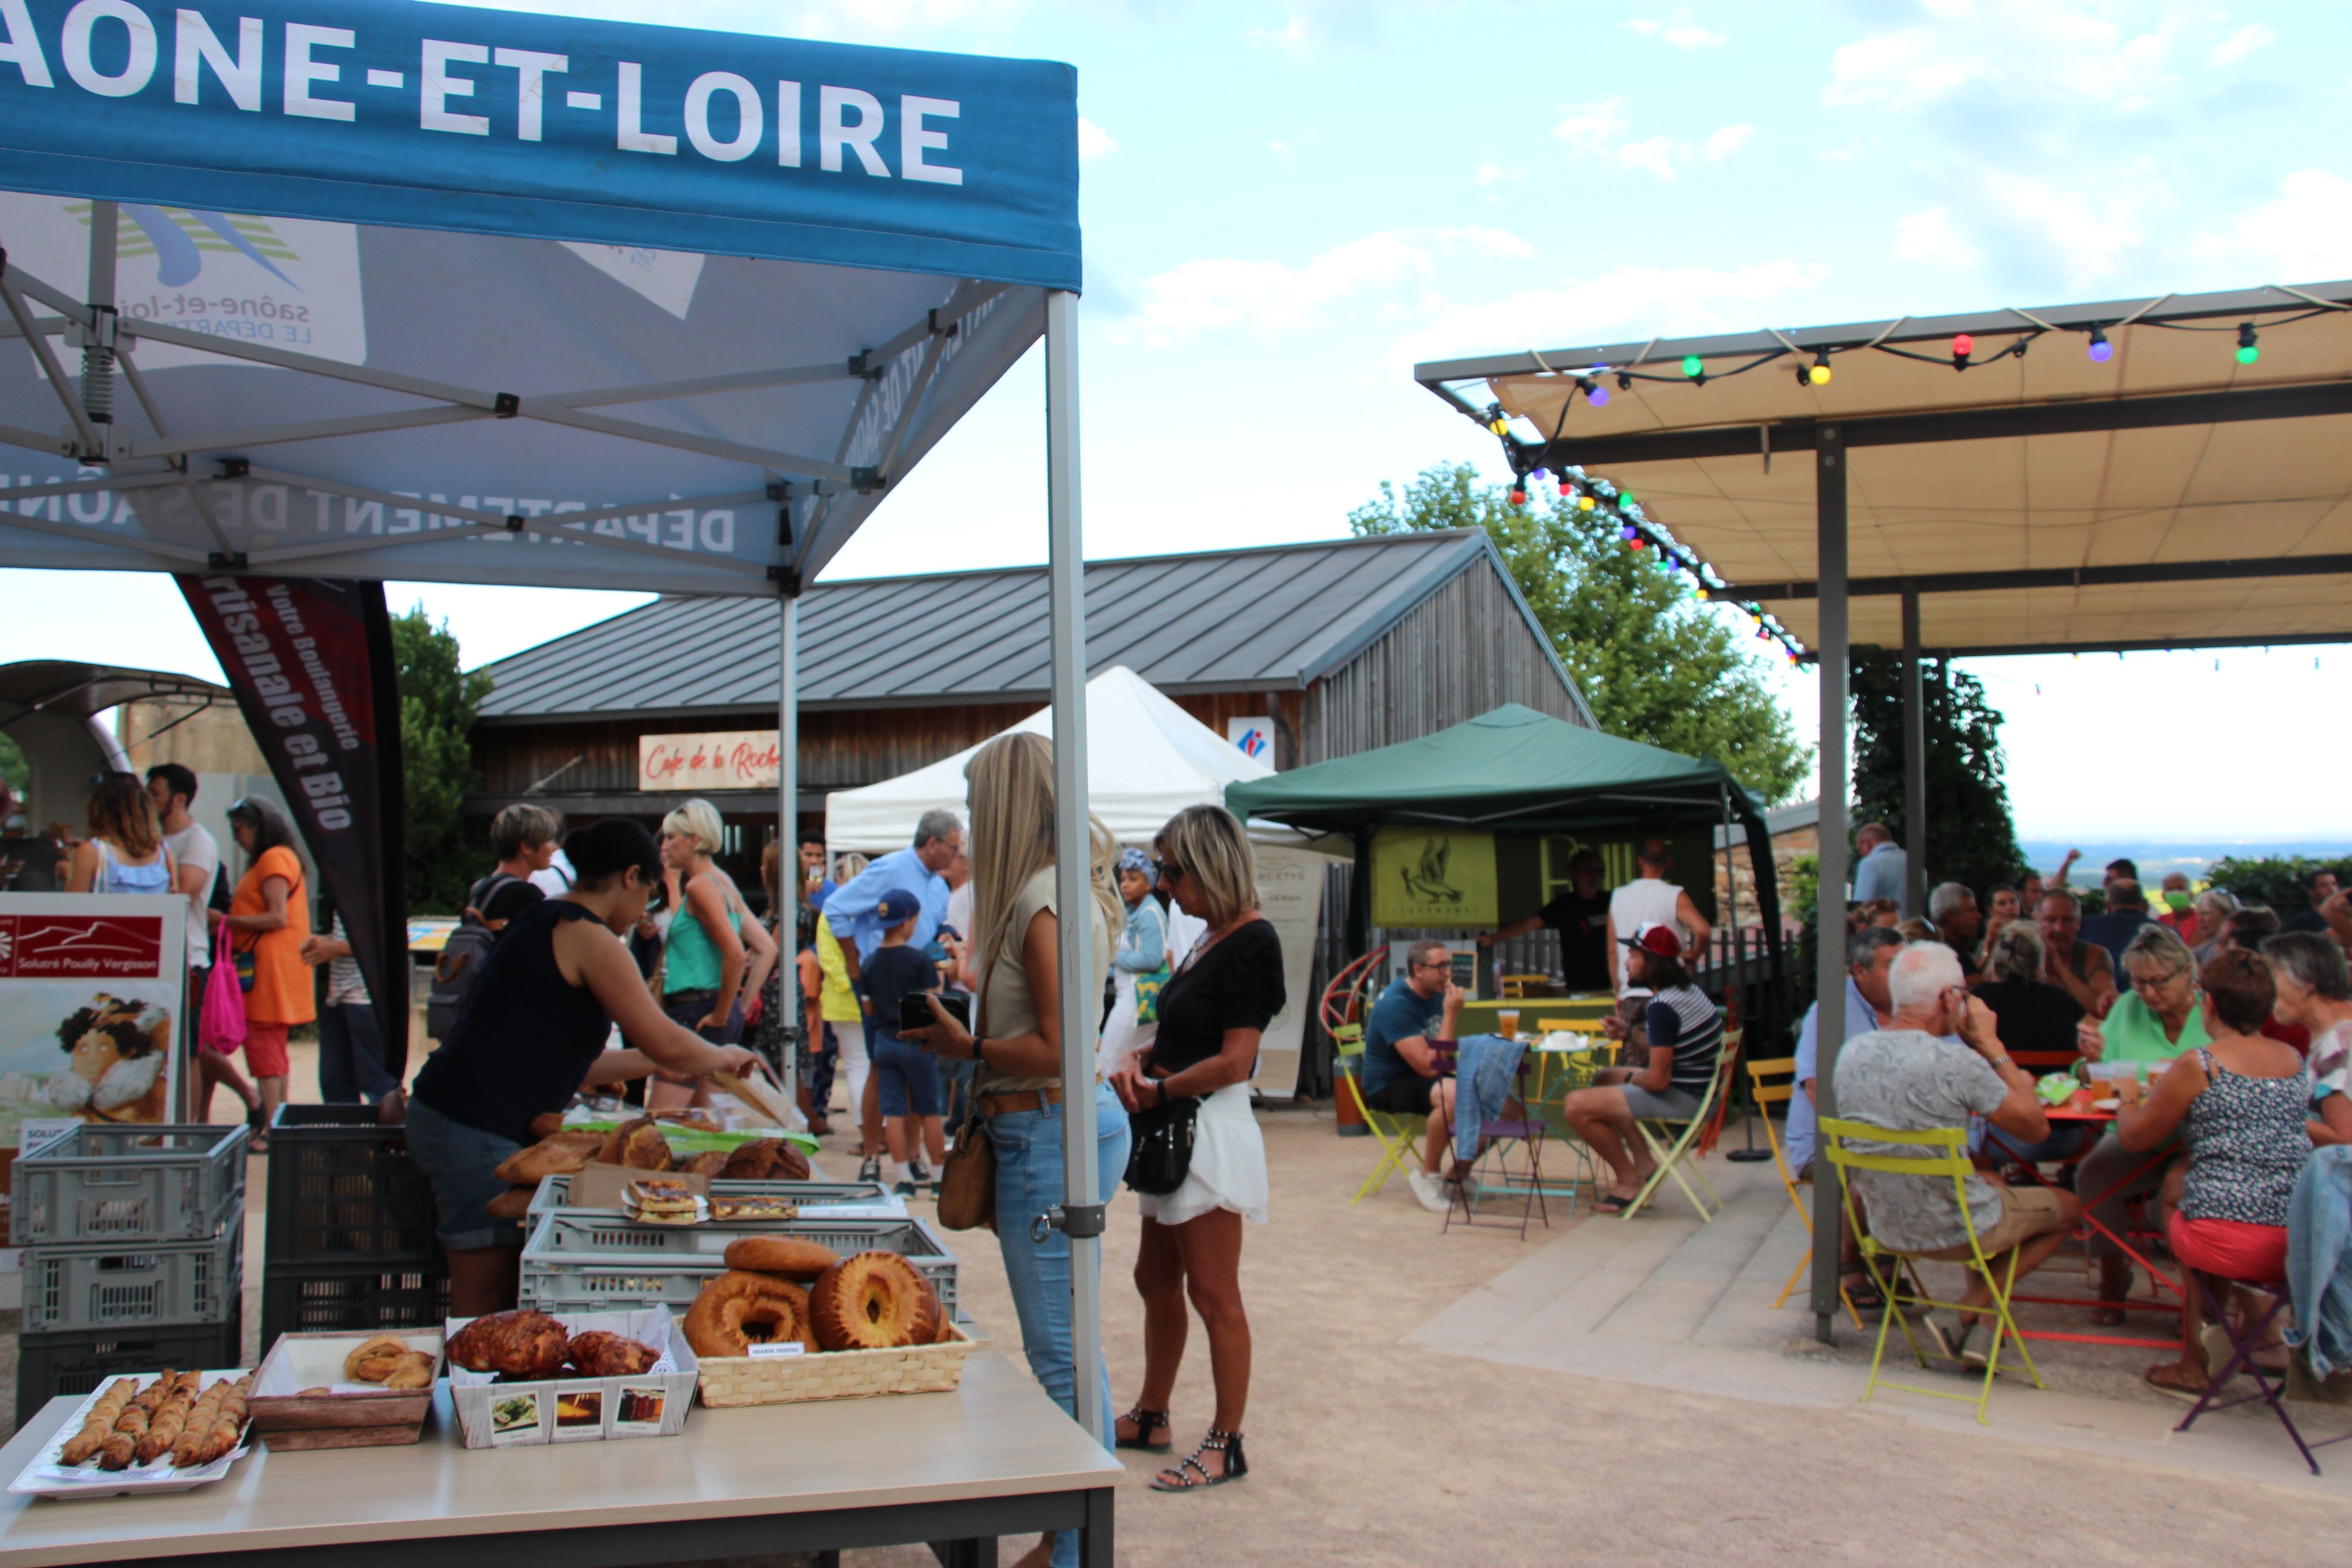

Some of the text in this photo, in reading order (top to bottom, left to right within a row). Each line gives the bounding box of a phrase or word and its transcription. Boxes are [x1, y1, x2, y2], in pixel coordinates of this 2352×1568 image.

[266, 583, 360, 750] Votre Boulangerie
[197, 575, 353, 831] rtisanale et Bio
[689, 744, 707, 770] de
[1257, 872, 1305, 881] NCETYS
[18, 957, 157, 973] Solutré Pouilly Vergisson
[27, 1129, 64, 1138] SOLUT
